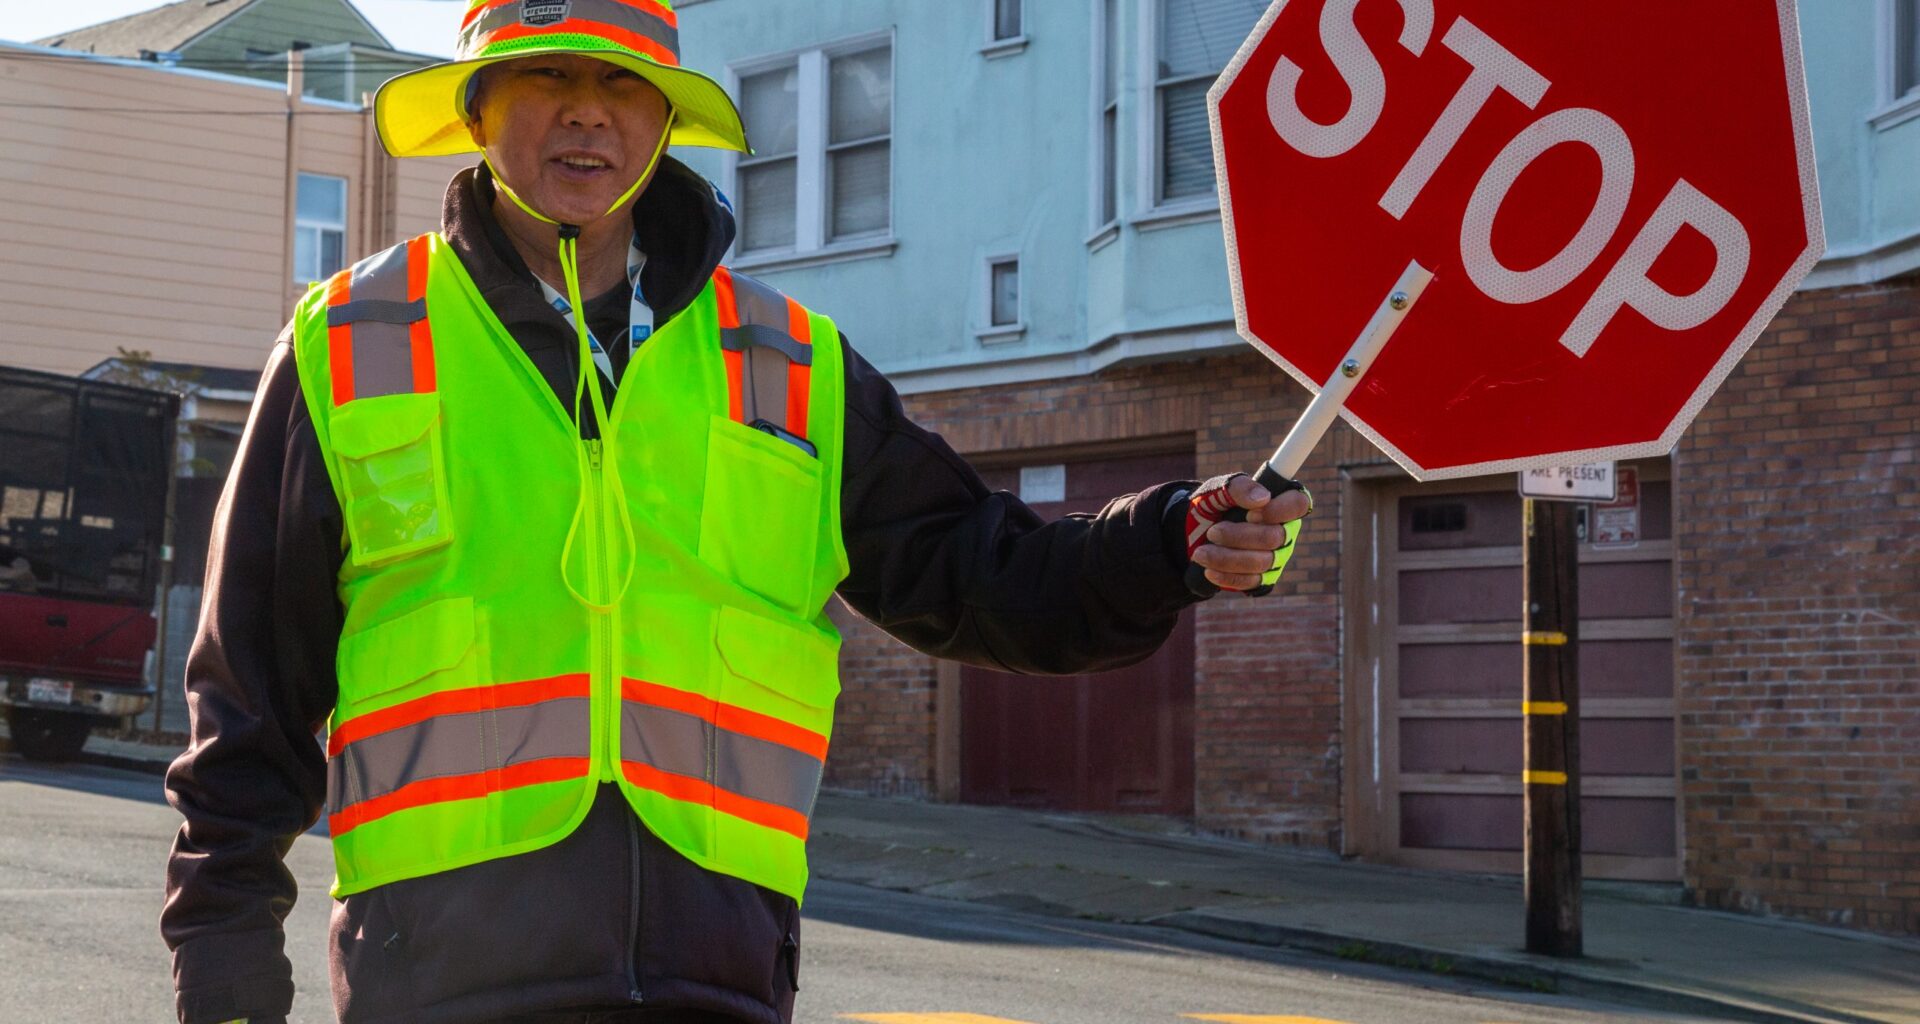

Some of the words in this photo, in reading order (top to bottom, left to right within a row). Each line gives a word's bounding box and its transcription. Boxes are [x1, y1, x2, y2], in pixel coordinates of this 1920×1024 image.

[1266, 0, 1751, 359] STOP
[1530, 467, 1553, 478] ARE
[1558, 466, 1607, 481] PRESENT
